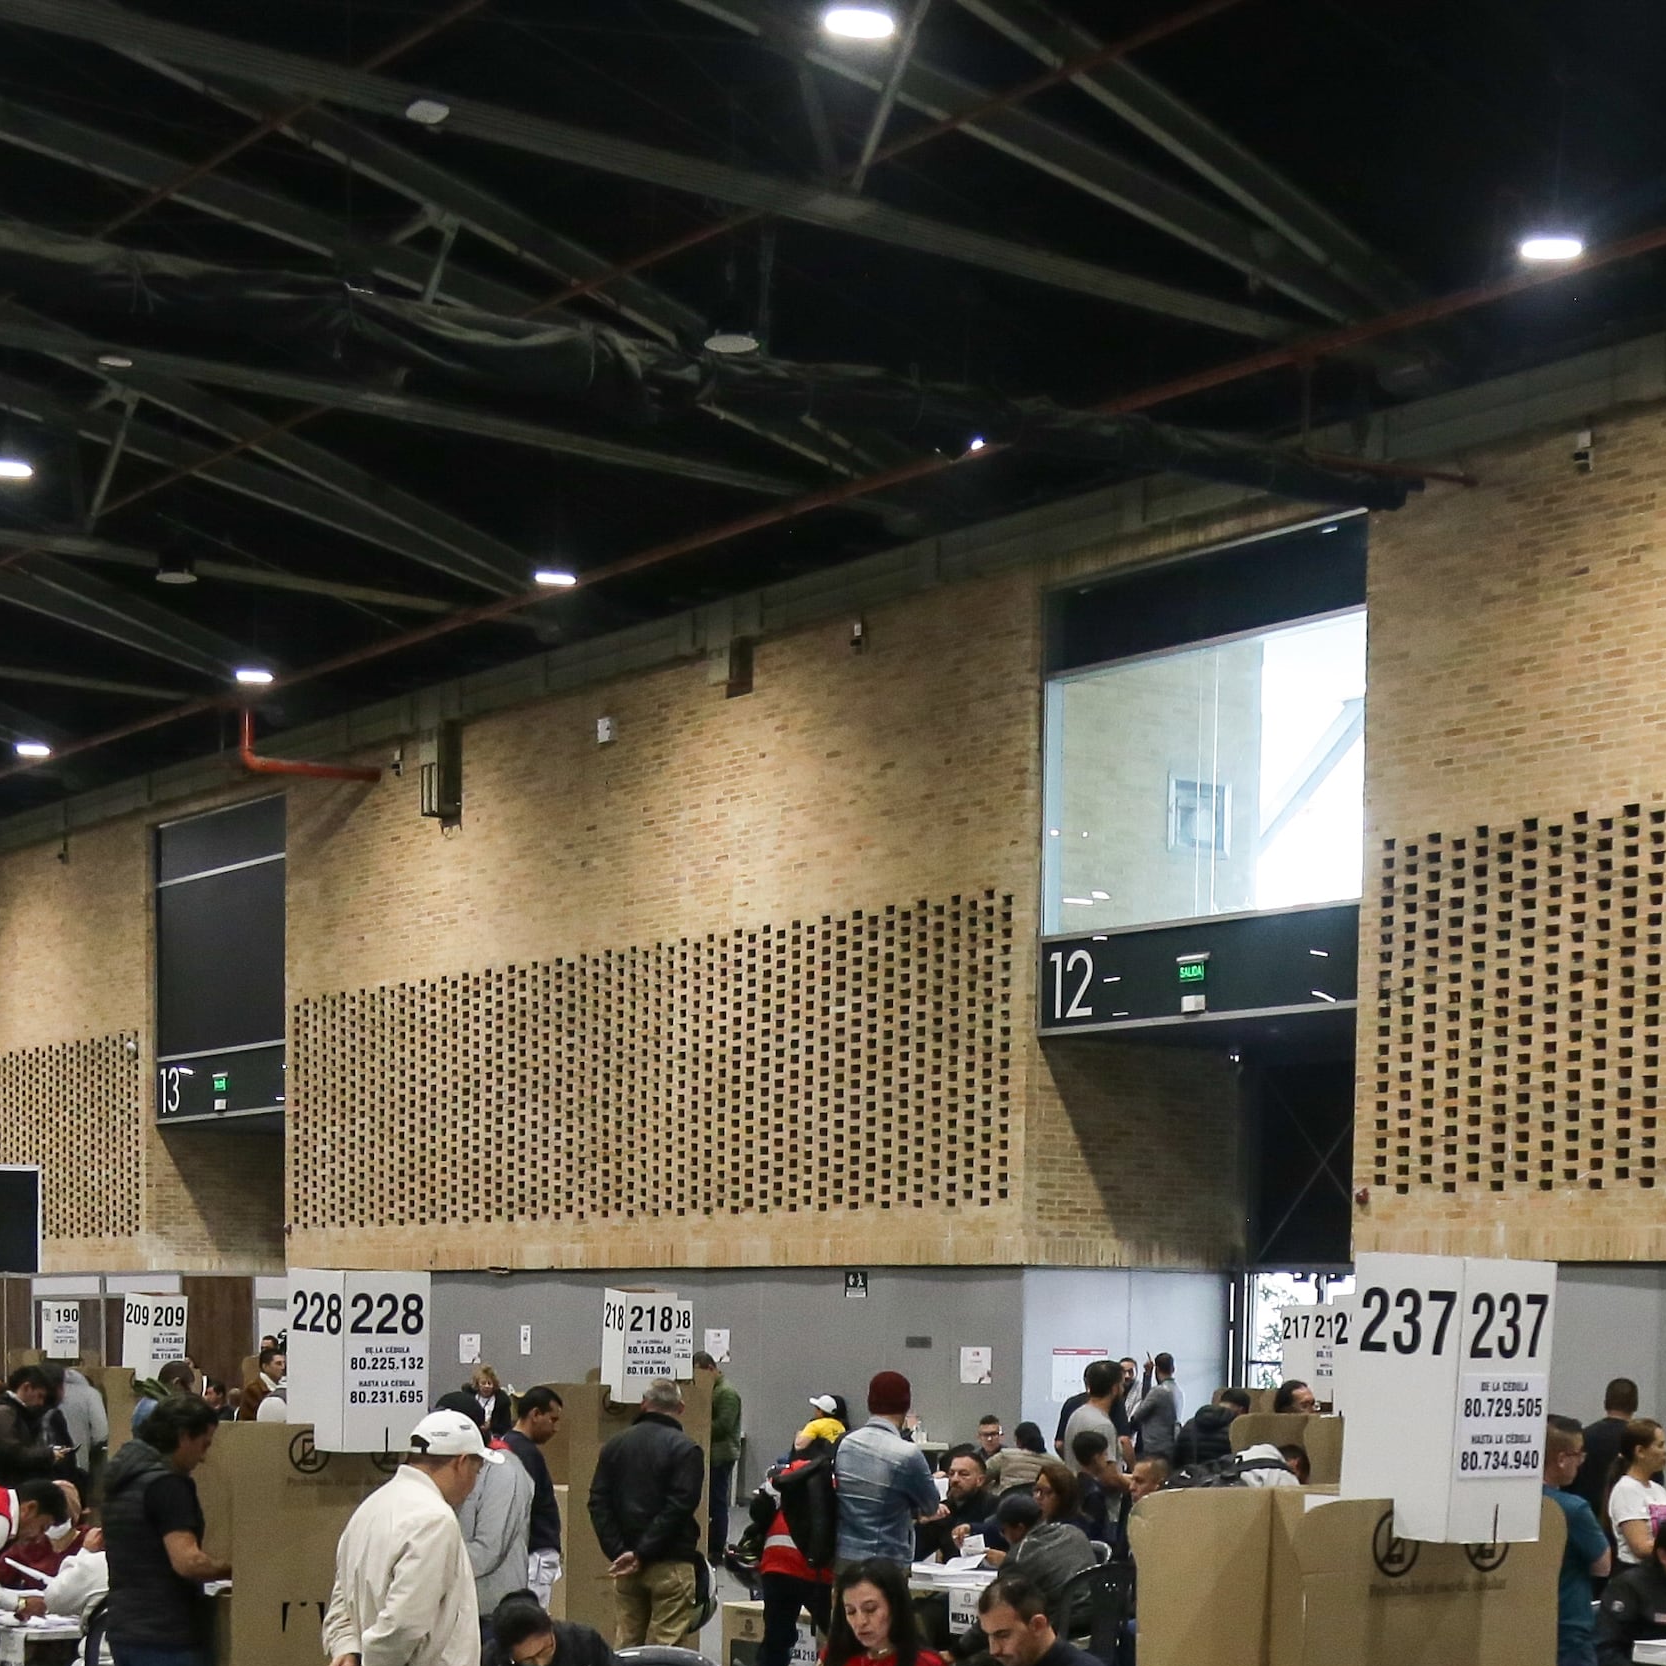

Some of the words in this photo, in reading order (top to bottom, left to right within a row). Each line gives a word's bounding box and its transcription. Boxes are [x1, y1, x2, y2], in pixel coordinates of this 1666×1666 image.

[1179, 965, 1203, 979] SALIDA
[1050, 950, 1094, 1019] 12
[160, 1067, 180, 1113] 13
[55, 1308, 78, 1323] 190
[126, 1303, 149, 1326] 209
[153, 1306, 185, 1327] 209
[292, 1290, 342, 1335] 228
[350, 1293, 424, 1335] 228
[605, 1302, 624, 1332] 218
[629, 1305, 673, 1332] 218
[1360, 1287, 1458, 1356] 237
[1283, 1315, 1310, 1340] 217
[1470, 1292, 1549, 1359] 237
[350, 1356, 424, 1370] 80.225.132
[350, 1390, 424, 1404] 80.231.695
[1492, 1382, 1501, 1392] LA
[1464, 1398, 1542, 1418] 80.729.505
[1461, 1450, 1539, 1471] 80.734.940
[951, 1612, 970, 1624] MESA
[802, 1649, 816, 1662] 218
